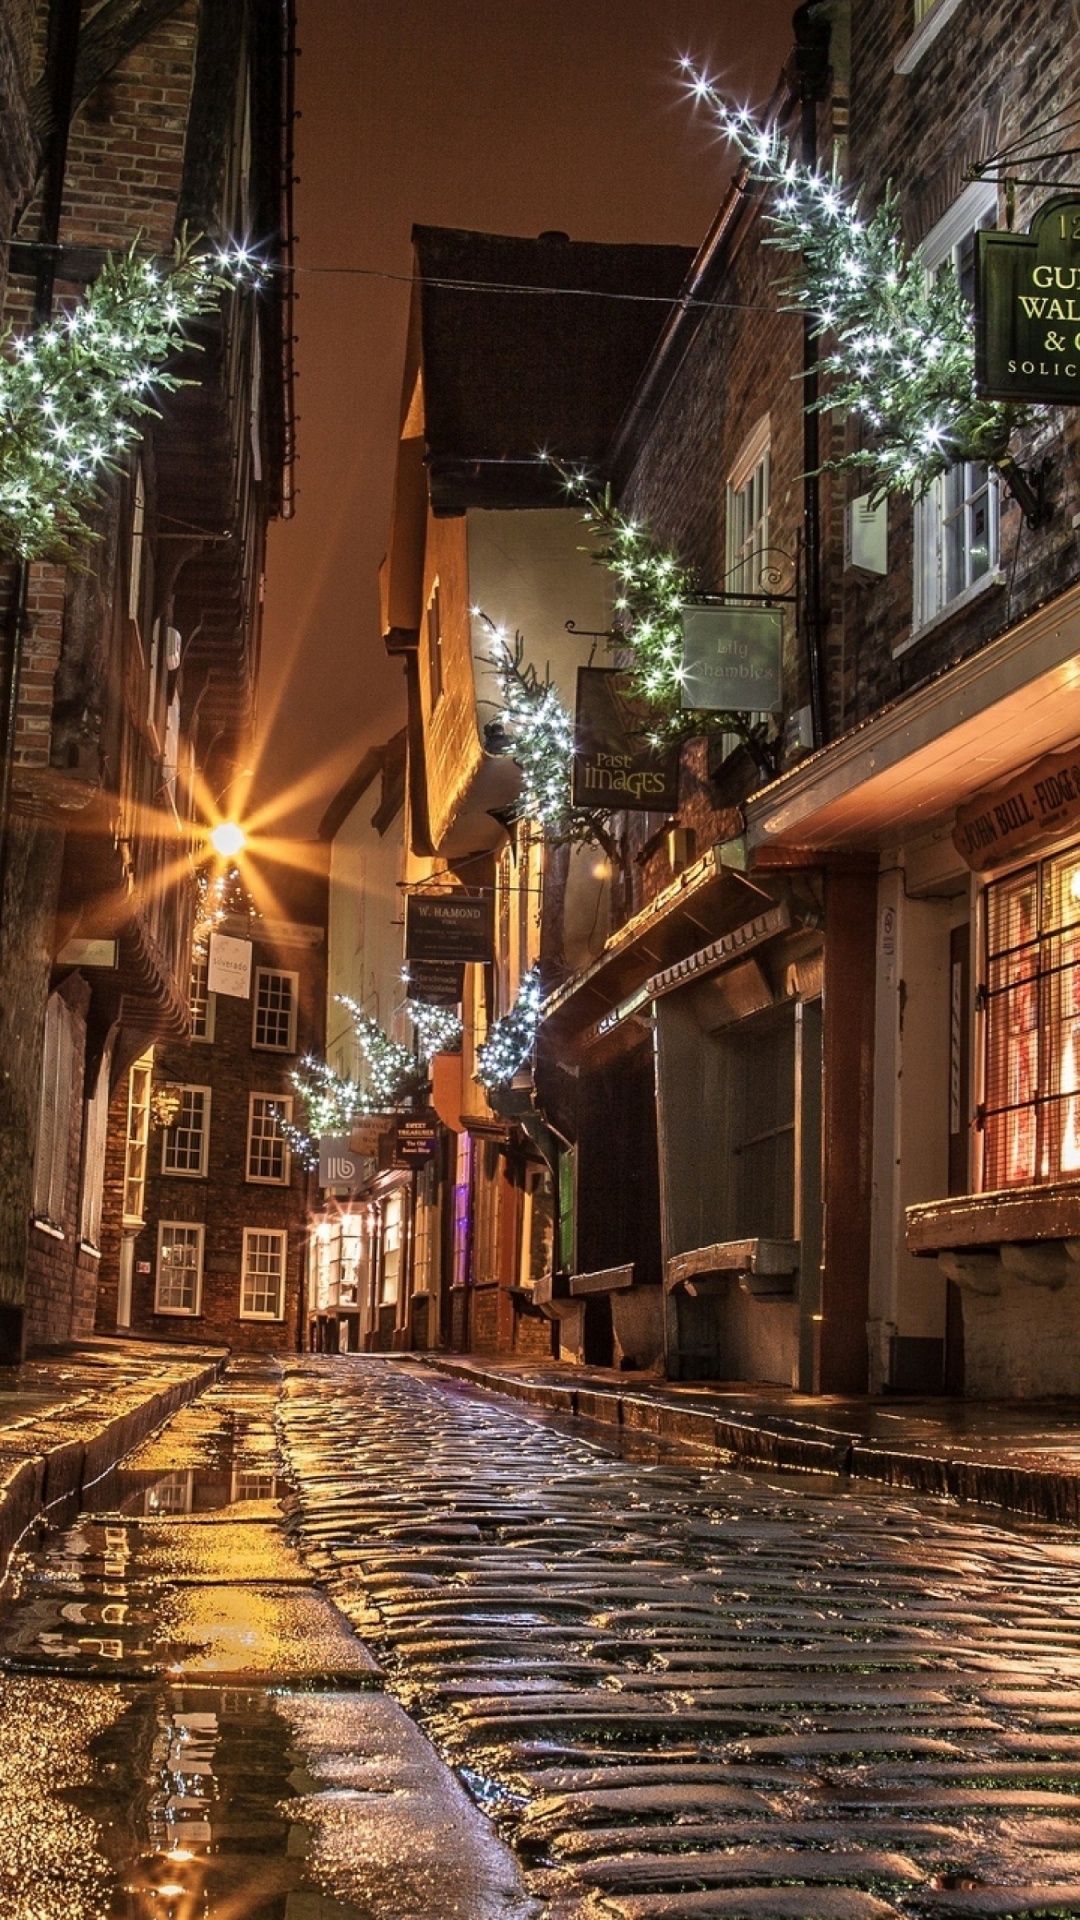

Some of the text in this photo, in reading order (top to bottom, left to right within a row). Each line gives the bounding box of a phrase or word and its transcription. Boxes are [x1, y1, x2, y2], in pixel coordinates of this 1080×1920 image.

[1032, 265, 1080, 290] GU
[1008, 360, 1077, 377] SOLIC
[717, 639, 748, 658] Lily
[694, 663, 773, 680] Shambles
[597, 752, 632, 769] Past
[963, 812, 998, 854] JOHN
[993, 793, 1035, 836] BULL
[1034, 769, 1077, 814] FUDGE
[434, 908, 481, 919] HAMOND
[213, 957, 248, 972] silverado
